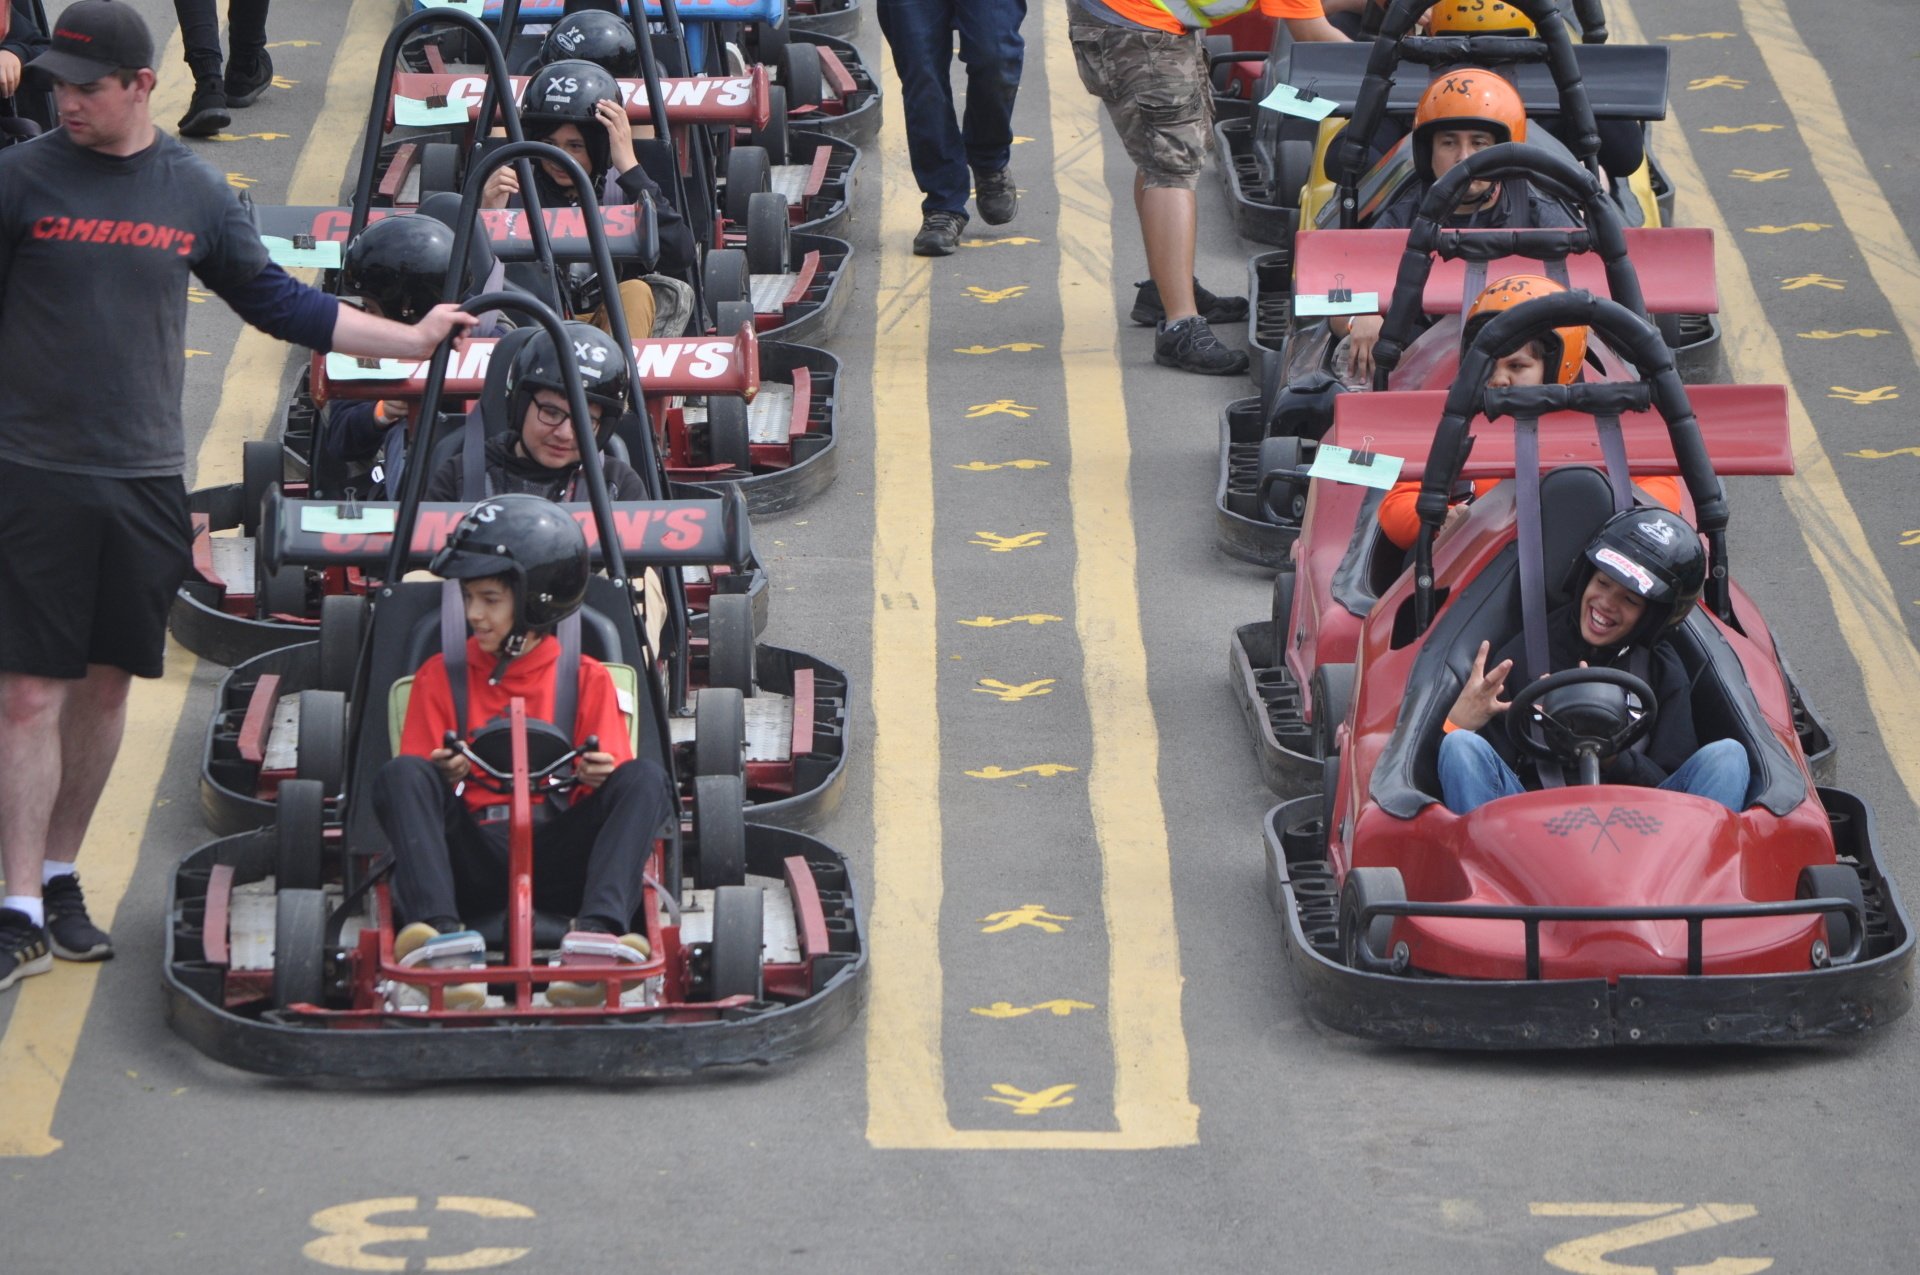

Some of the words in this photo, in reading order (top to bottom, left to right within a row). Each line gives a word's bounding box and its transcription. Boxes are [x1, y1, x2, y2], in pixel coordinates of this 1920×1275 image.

[566, 26, 585, 43] XS
[545, 76, 579, 94] XS
[1442, 77, 1474, 94] XS
[32, 216, 195, 256] CAMERON'S
[573, 340, 609, 363] XS
[302, 1196, 537, 1271] 3
